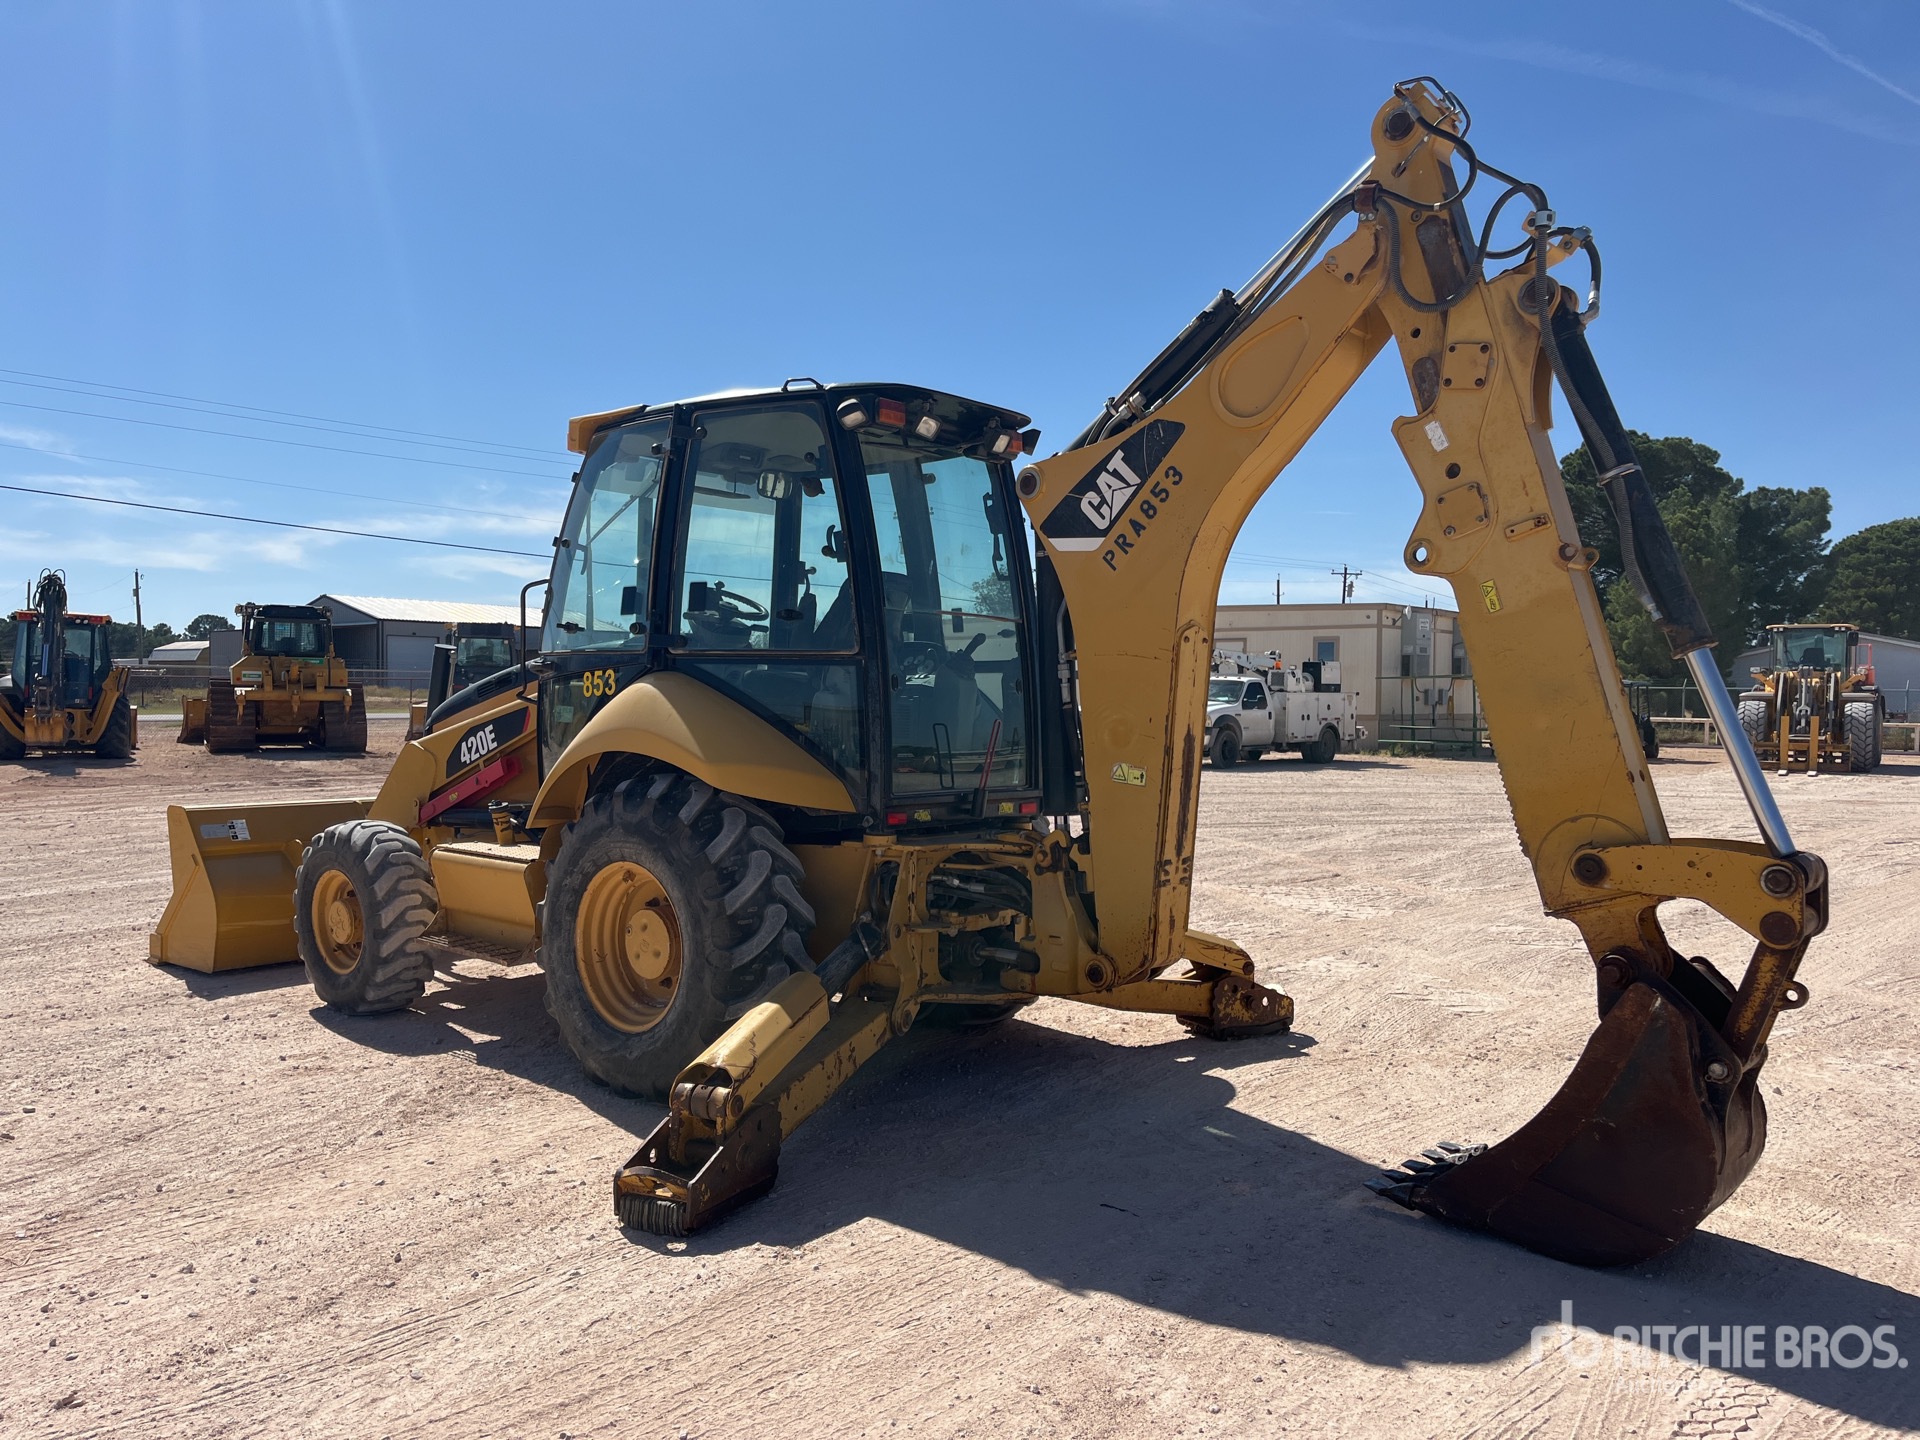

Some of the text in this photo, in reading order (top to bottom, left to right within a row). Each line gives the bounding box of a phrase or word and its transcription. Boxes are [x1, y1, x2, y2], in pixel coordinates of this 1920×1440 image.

[1080, 449, 1142, 530] CAT
[1102, 465, 1183, 572] PRA853
[583, 669, 616, 698] 853
[460, 723, 498, 765] 420E
